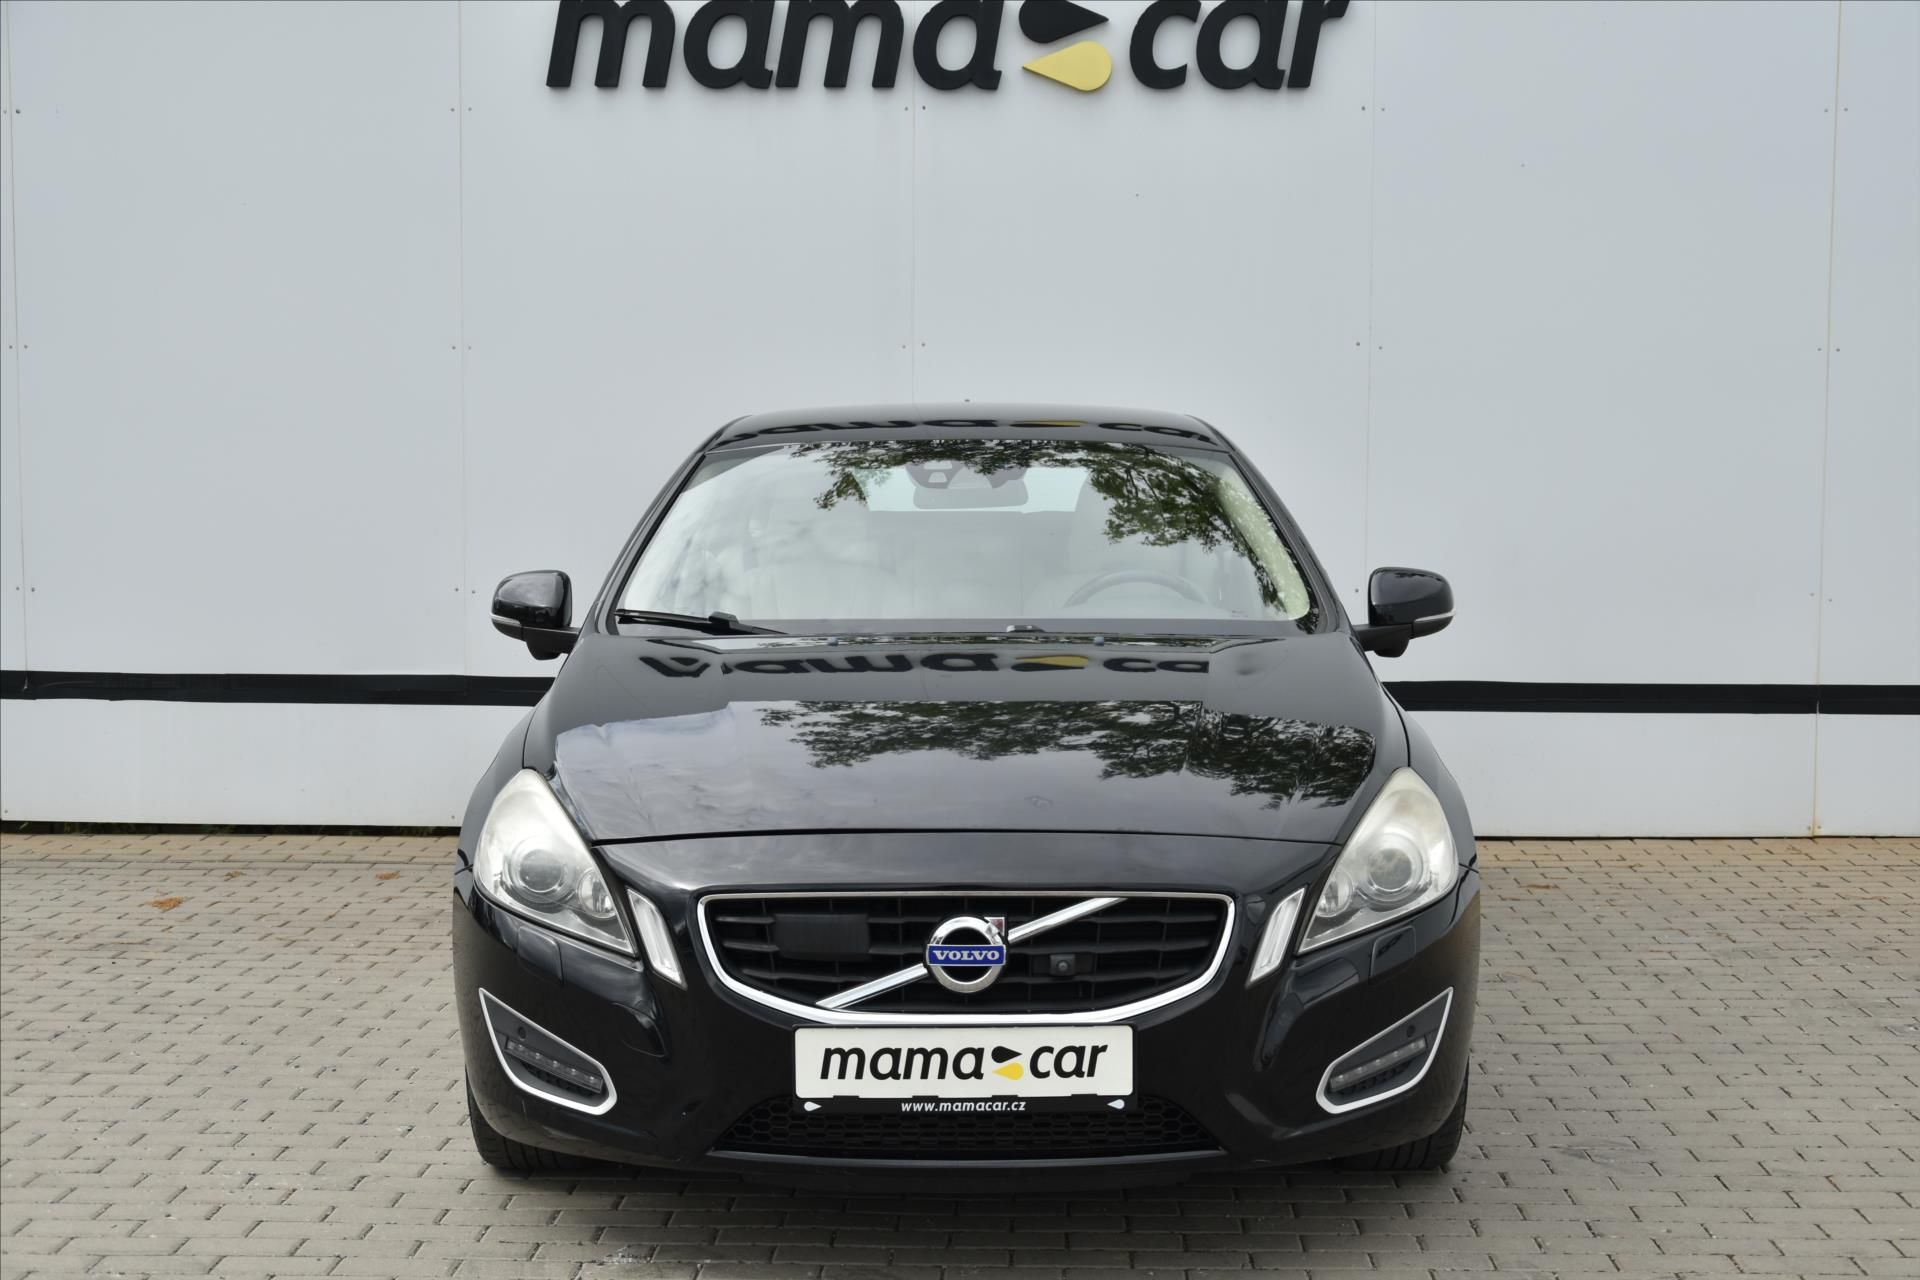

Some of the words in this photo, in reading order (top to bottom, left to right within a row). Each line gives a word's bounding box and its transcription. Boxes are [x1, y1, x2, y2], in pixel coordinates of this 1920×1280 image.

[545, 0, 1001, 91] mama
[1129, 0, 1350, 90] car
[932, 950, 1000, 961] VOLVO
[820, 1047, 985, 1081] mama
[1029, 1044, 1109, 1079] car
[901, 1101, 1026, 1112] www.mamacar.cz
